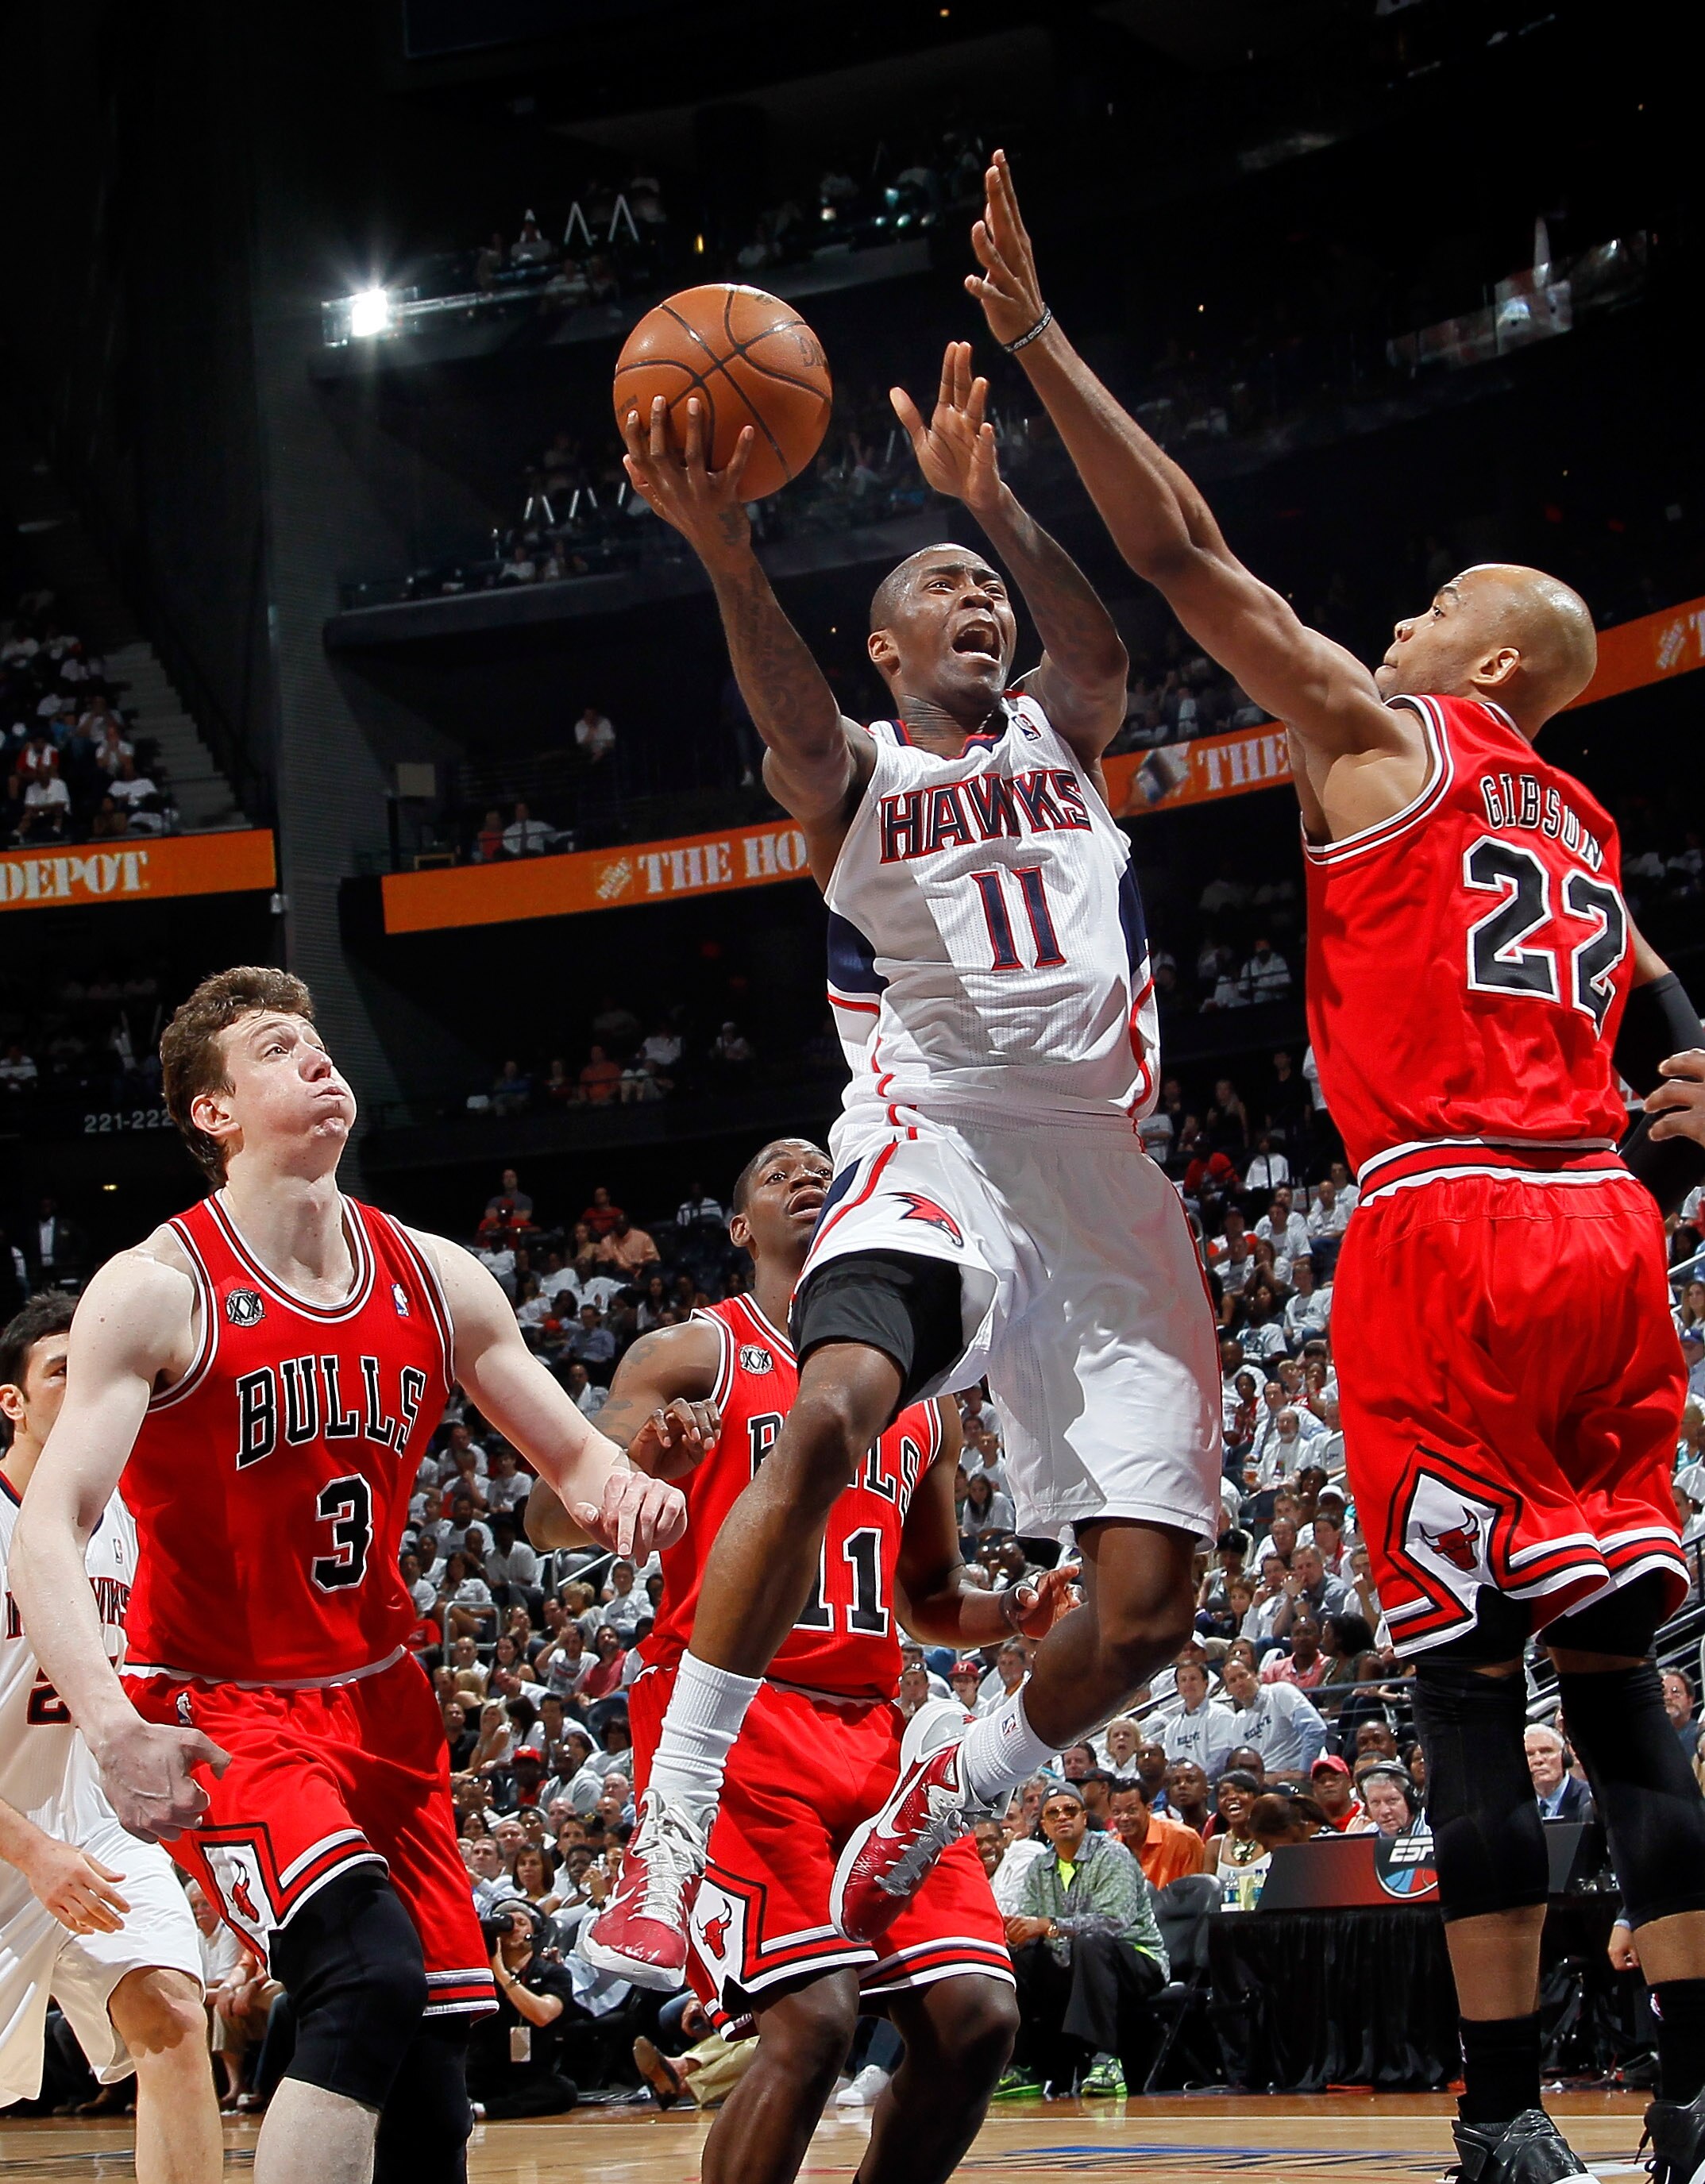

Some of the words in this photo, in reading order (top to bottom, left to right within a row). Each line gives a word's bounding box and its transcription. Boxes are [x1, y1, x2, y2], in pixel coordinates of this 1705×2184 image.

[1198, 732, 1291, 791] THE
[638, 842, 733, 894] THE
[743, 830, 809, 878] HO
[879, 769, 1094, 864] HAWKS
[1479, 774, 1603, 873] GIBSON
[0, 851, 149, 902] DEPOT
[970, 866, 1067, 970] 11
[1463, 834, 1627, 1041] 22
[235, 1354, 426, 1471] BULLS
[311, 1472, 373, 1594] 3
[1389, 1836, 1436, 1863] ESP
